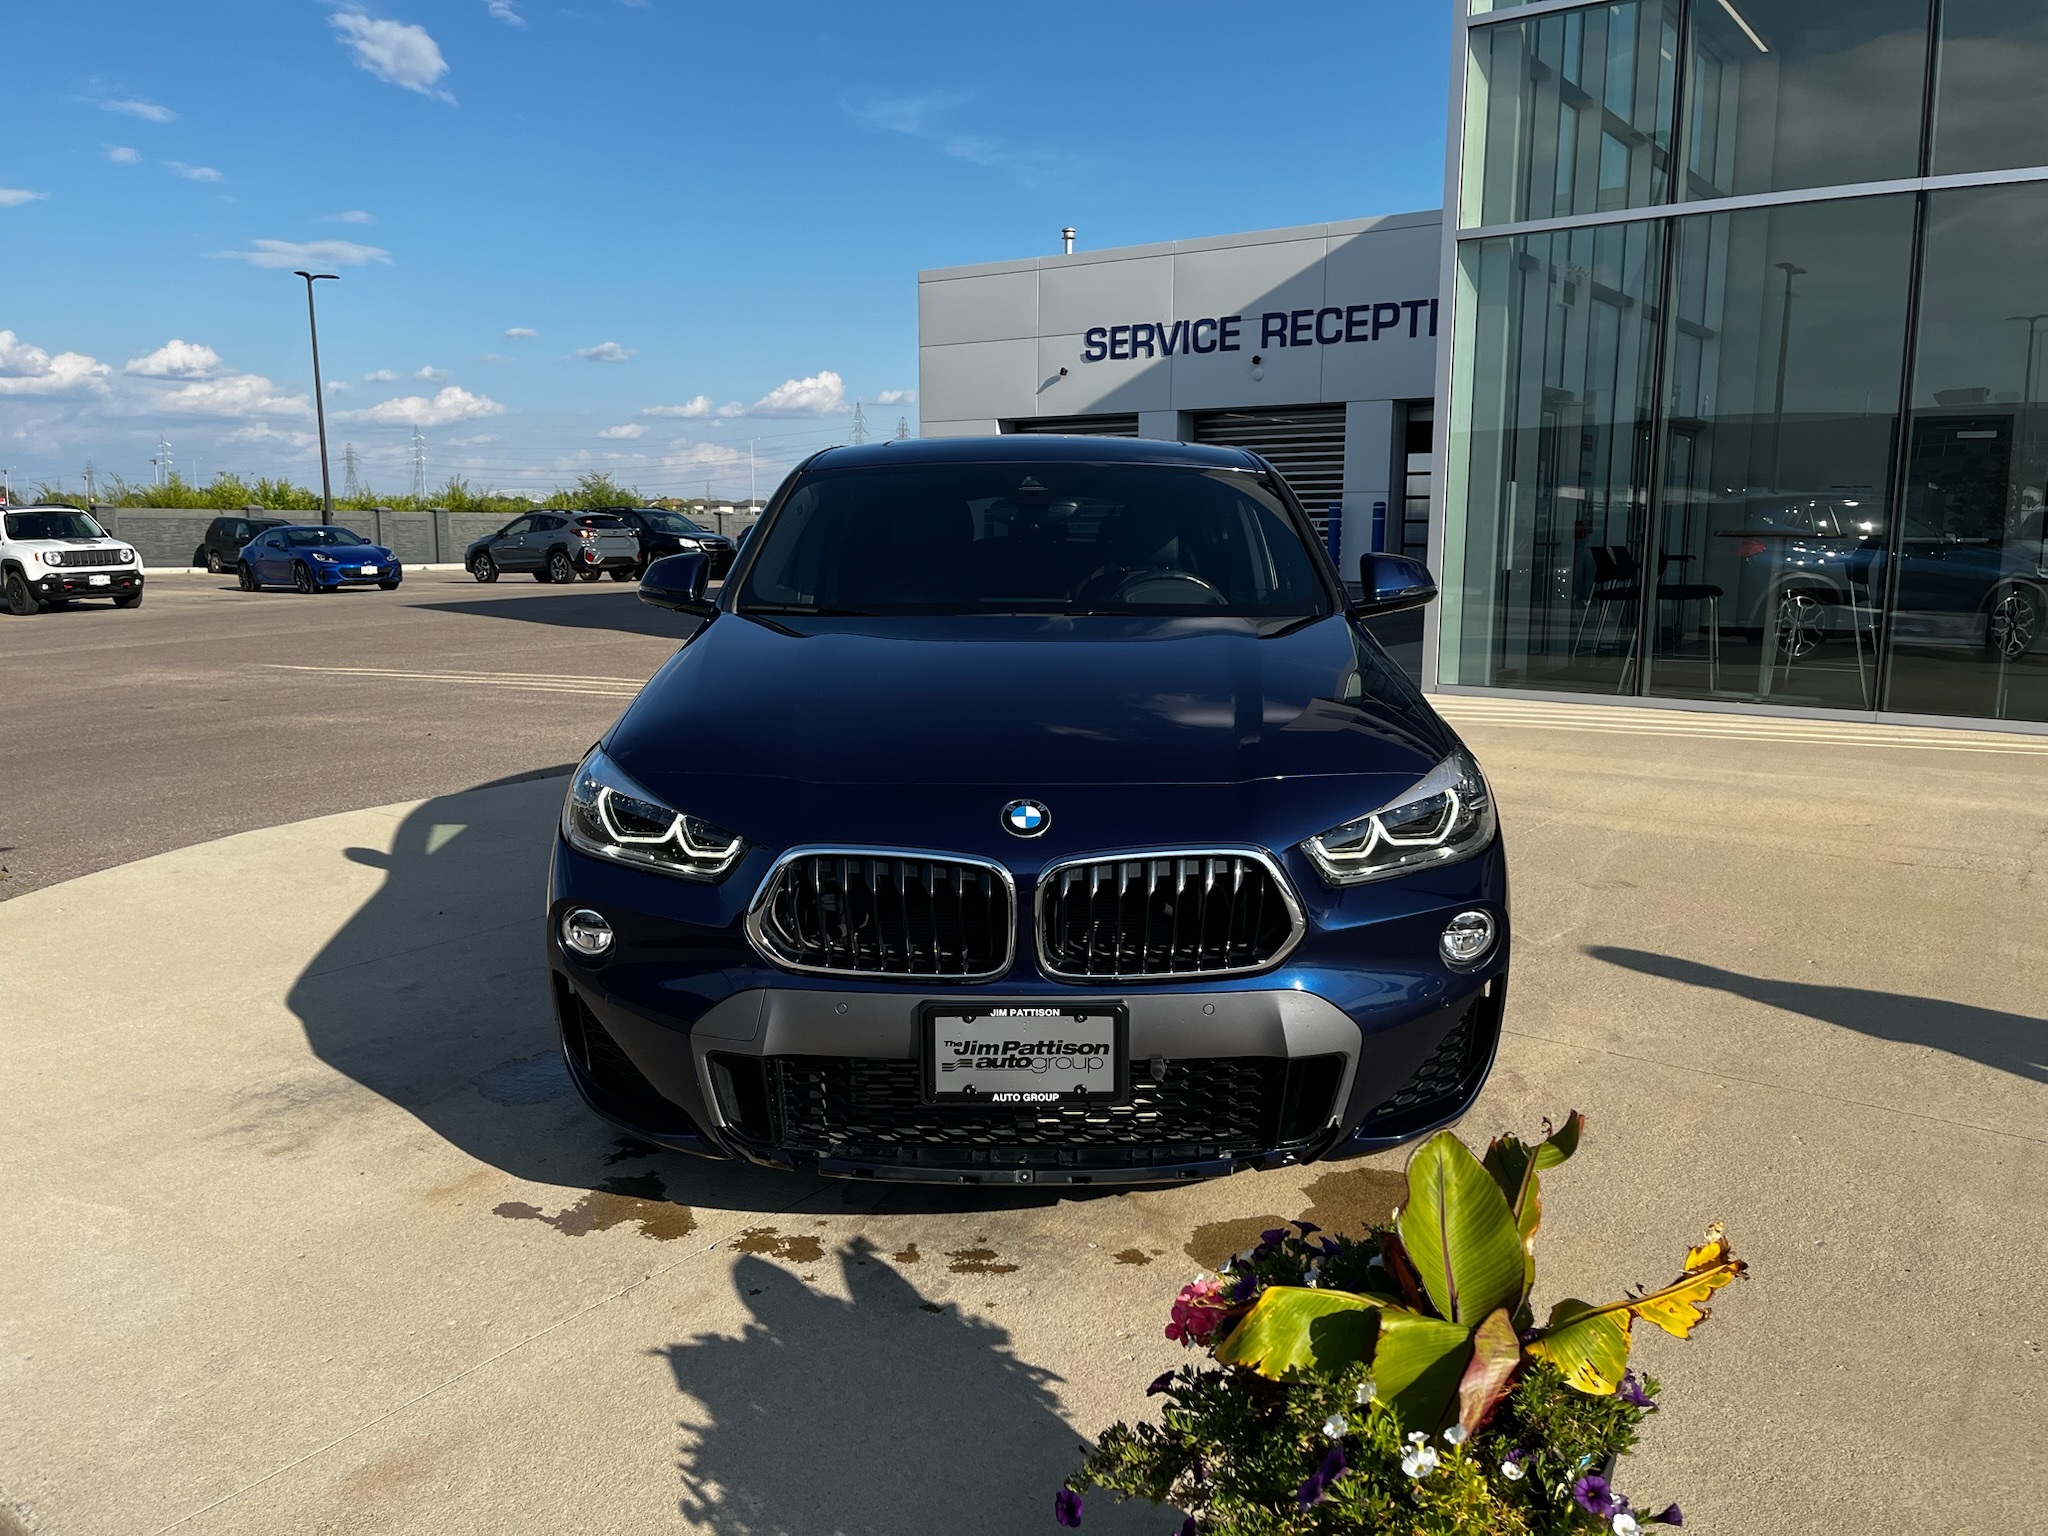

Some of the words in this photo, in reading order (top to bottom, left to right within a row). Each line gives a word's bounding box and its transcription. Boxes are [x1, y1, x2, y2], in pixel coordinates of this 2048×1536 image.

[1084, 315, 1242, 362] SERVICE
[1006, 800, 1047, 812] BMW
[989, 1008, 1008, 1017] JIM
[1009, 1008, 1061, 1017] PATTISON
[943, 1040, 963, 1048] The
[992, 1093, 1021, 1102] AUTO
[1022, 1093, 1060, 1102] GROUP
